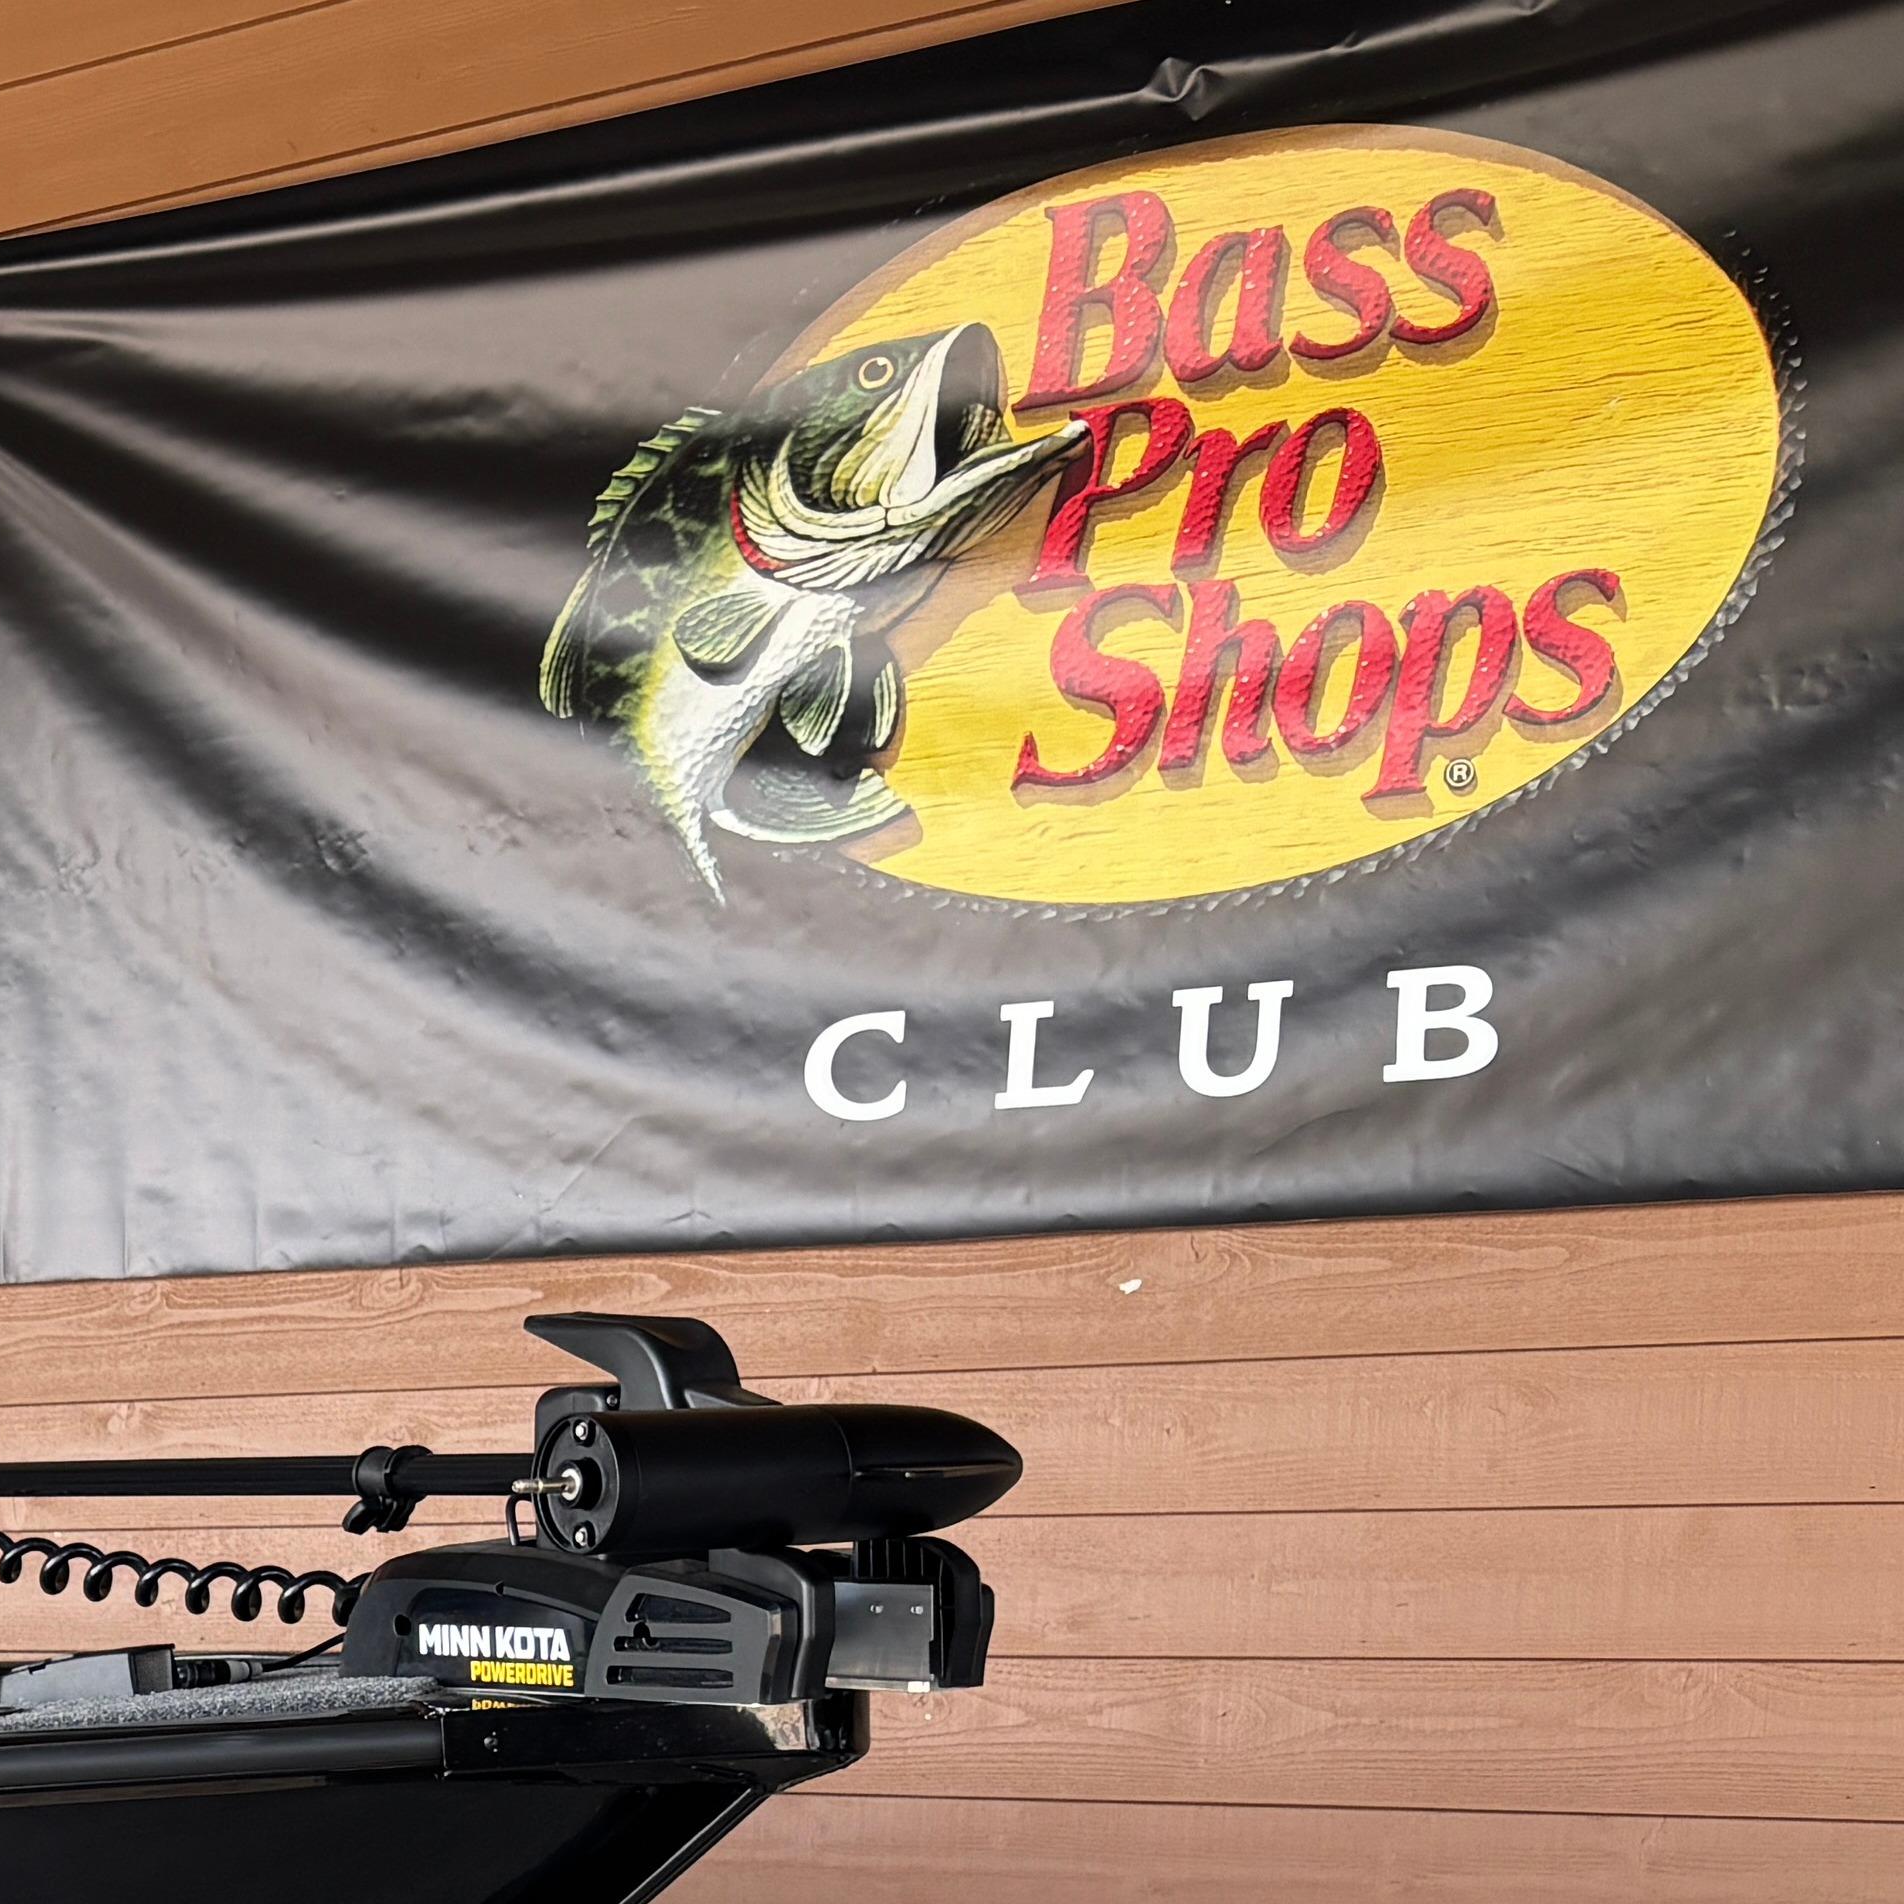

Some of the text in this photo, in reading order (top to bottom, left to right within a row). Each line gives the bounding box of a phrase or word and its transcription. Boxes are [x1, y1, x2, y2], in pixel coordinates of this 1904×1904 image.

[1011, 188, 1497, 410] Bass
[1013, 396, 1382, 593] Pro
[1010, 568, 1622, 801] Shops
[803, 964, 1499, 1121] CLUB
[418, 1623, 571, 1662] MINN KOTA
[470, 1660, 574, 1687] POWERDRIVE
